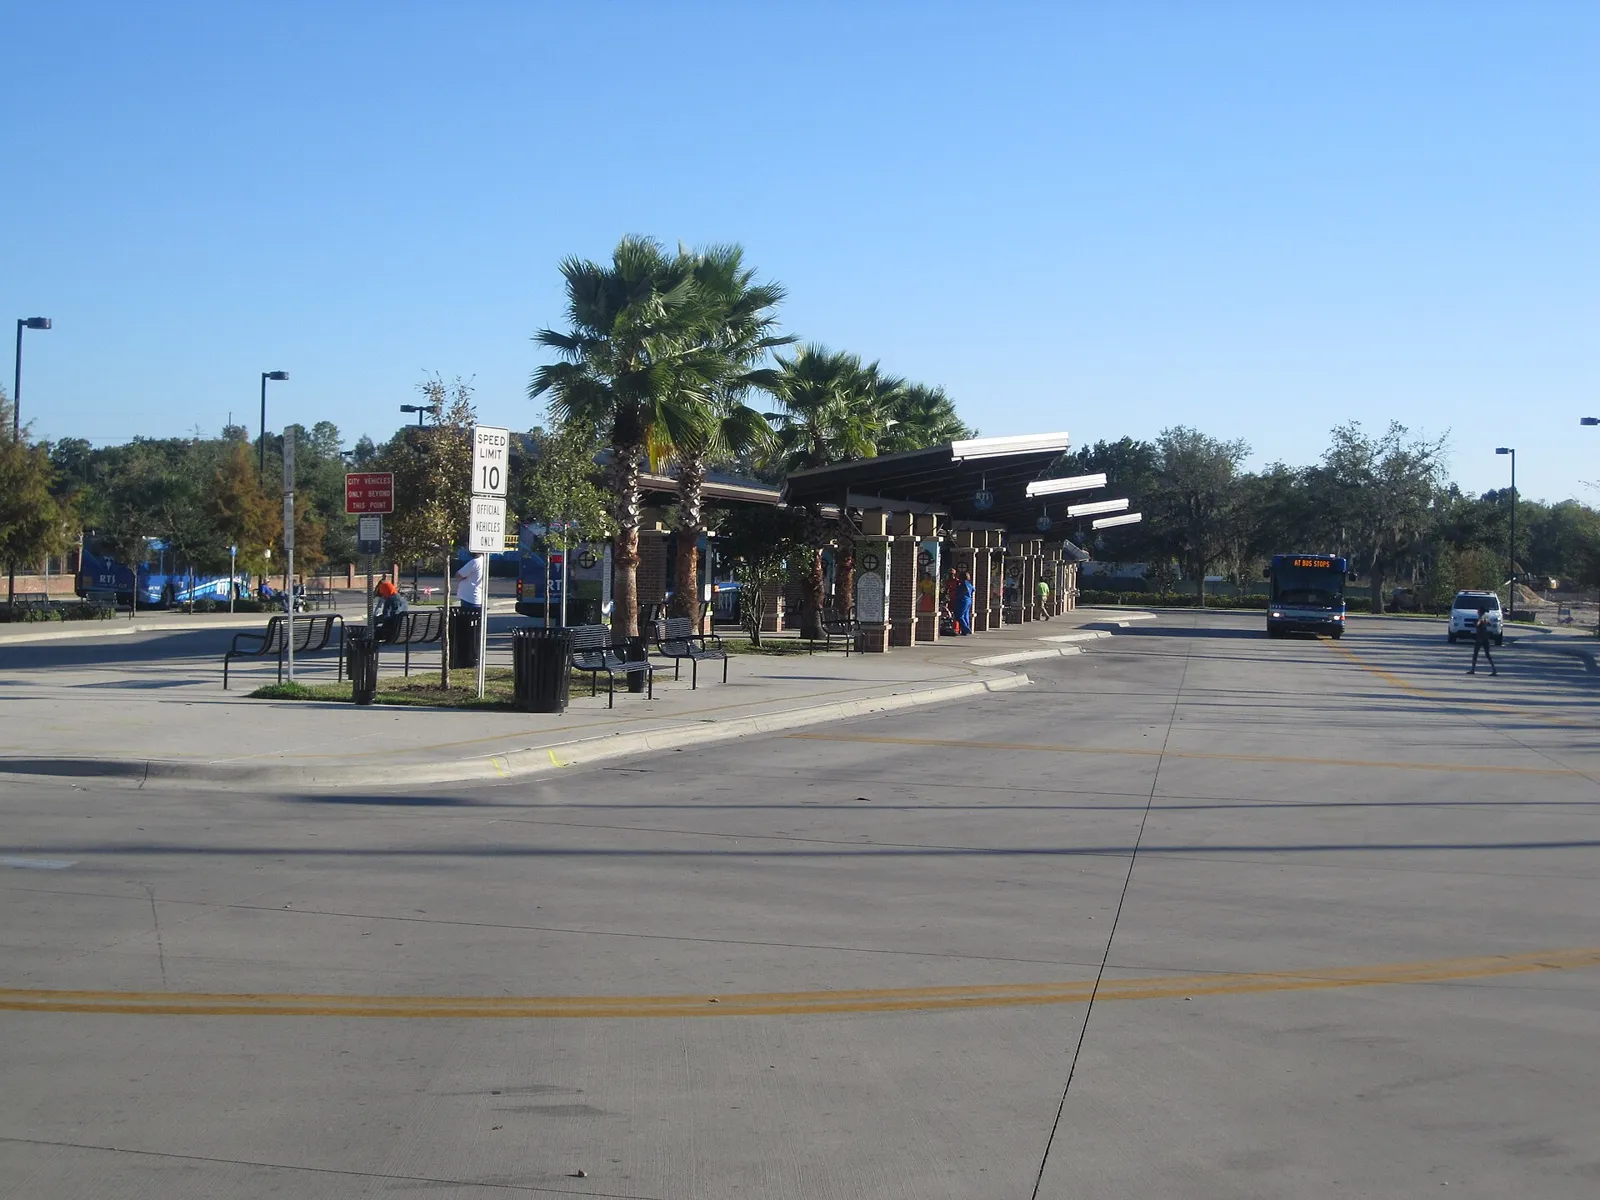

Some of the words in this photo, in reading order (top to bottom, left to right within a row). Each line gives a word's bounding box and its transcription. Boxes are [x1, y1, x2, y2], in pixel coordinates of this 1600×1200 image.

[477, 434, 506, 446] SPEED
[480, 449, 502, 460] LIMIT
[364, 477, 391, 485] VEHICLES
[483, 466, 500, 490] 10
[348, 490, 363, 498] ONLY
[370, 501, 387, 509] POINT
[476, 504, 500, 515] OFFICIAL
[475, 521, 500, 533] VEHICLES
[480, 536, 495, 547] ONLY
[1314, 560, 1330, 568] STOPS
[549, 579, 563, 591] RT
